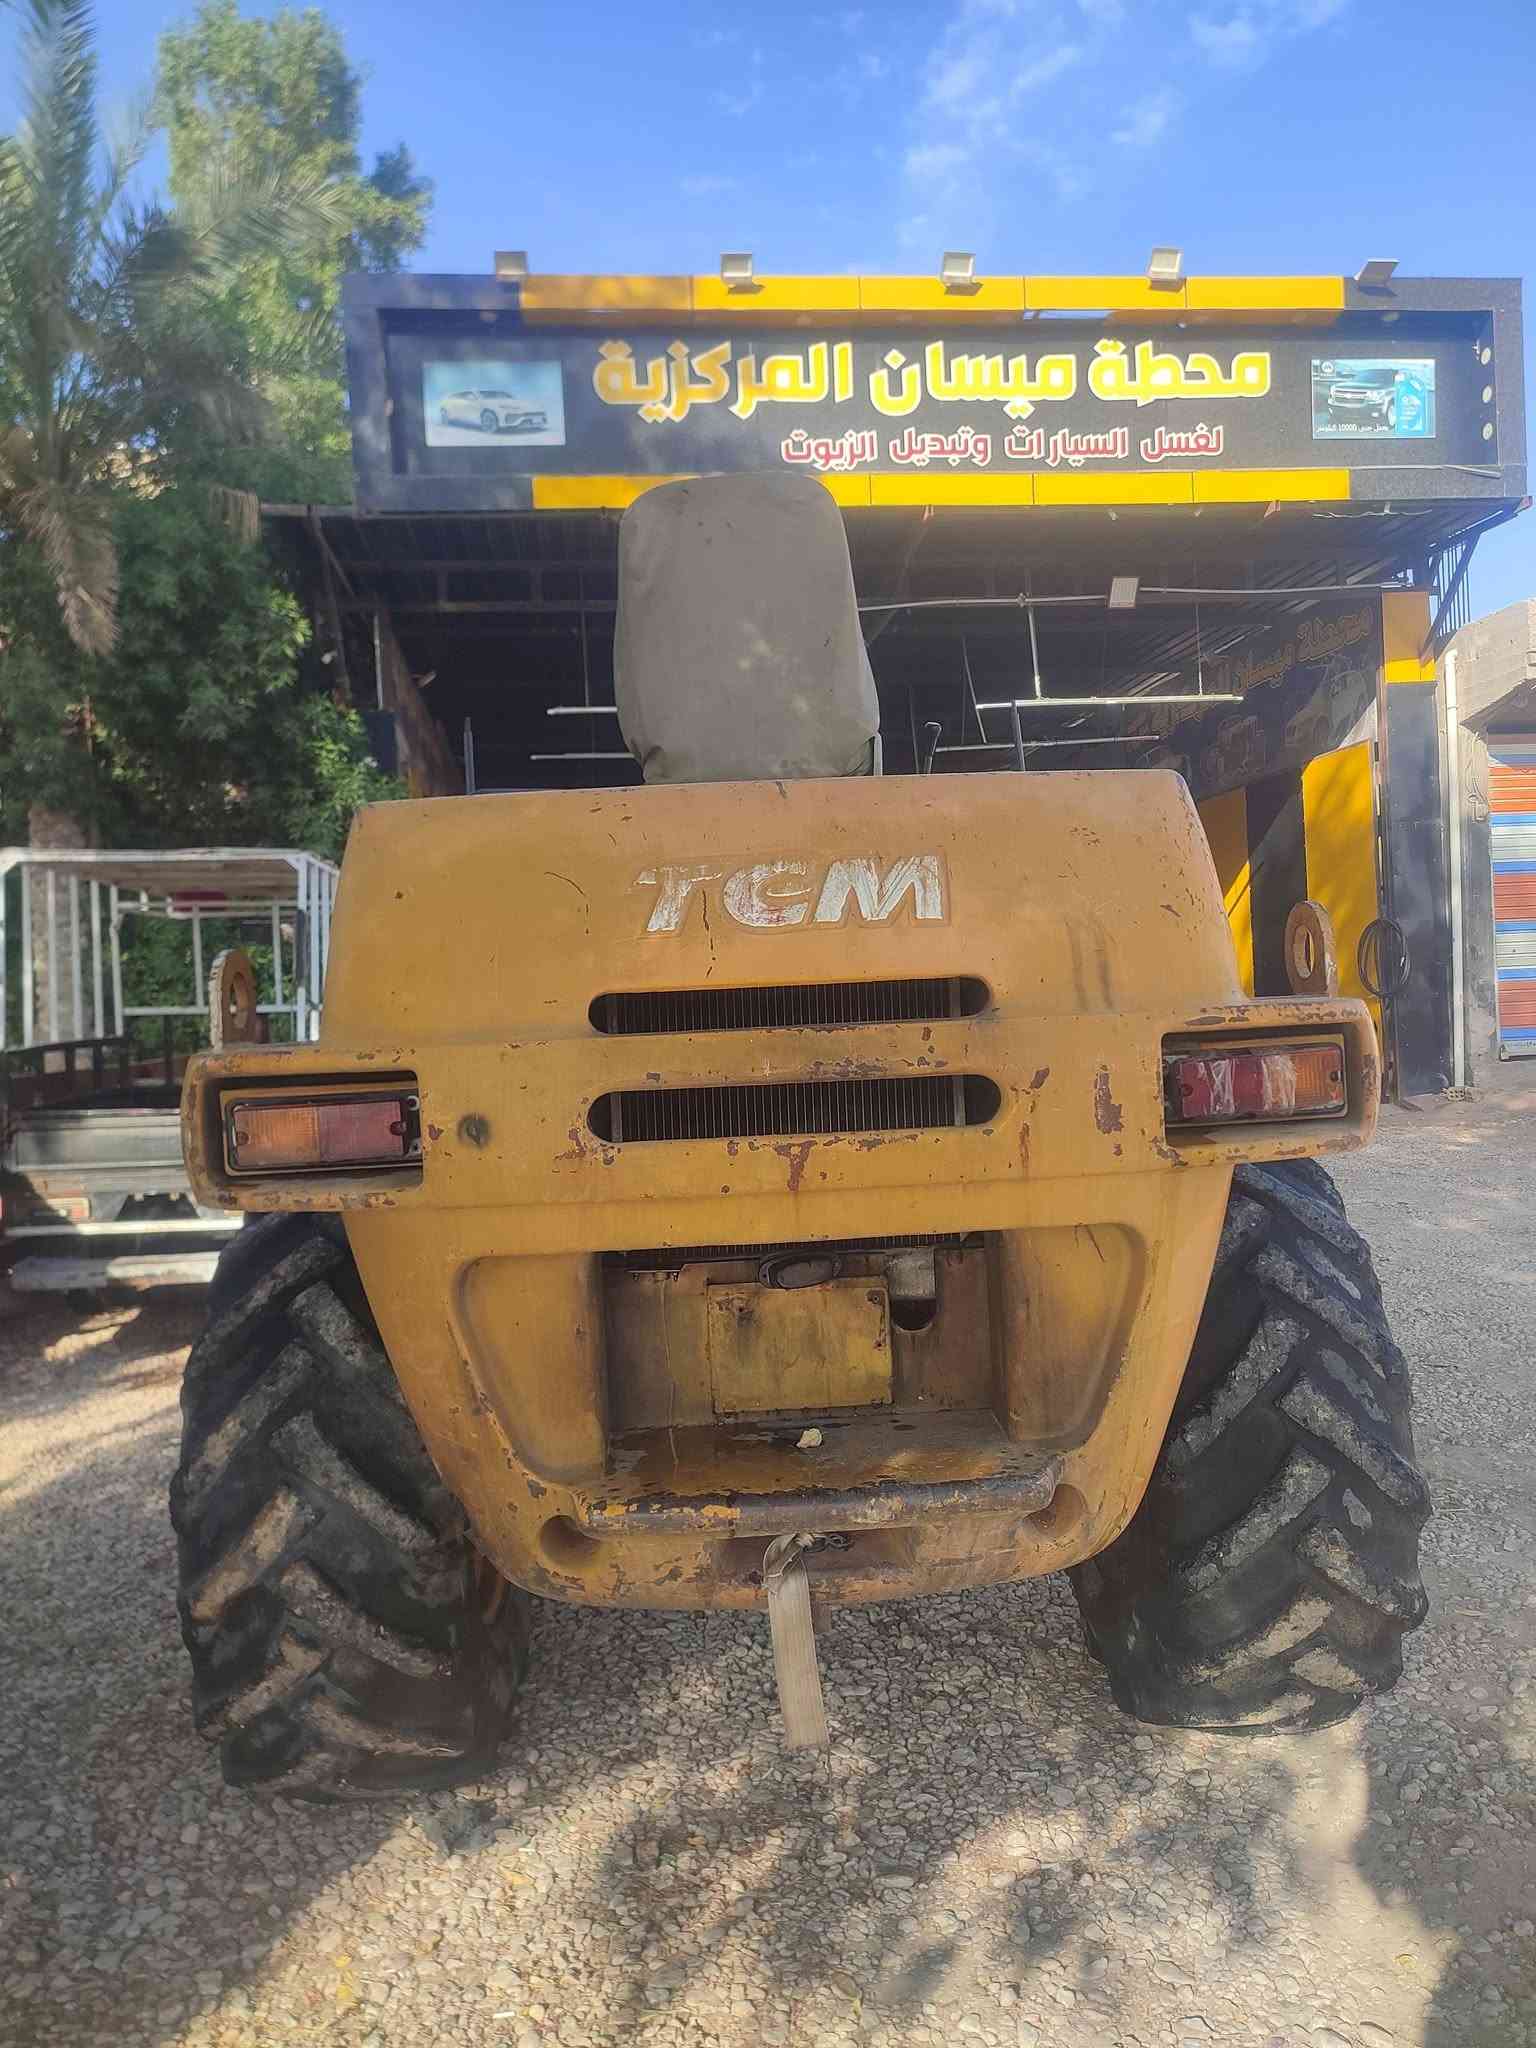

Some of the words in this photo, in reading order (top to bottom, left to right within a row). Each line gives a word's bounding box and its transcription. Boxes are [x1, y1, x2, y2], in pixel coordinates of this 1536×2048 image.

[593, 341, 854, 423] المركزية
[870, 341, 1077, 420] ميسان
[1088, 339, 1270, 407] محطة
[781, 429, 878, 471] الزيوت
[889, 425, 991, 466] وتبديل
[1004, 425, 1129, 467] السيارات
[1140, 422, 1224, 463] لغسل
[634, 855, 944, 932] TCM
